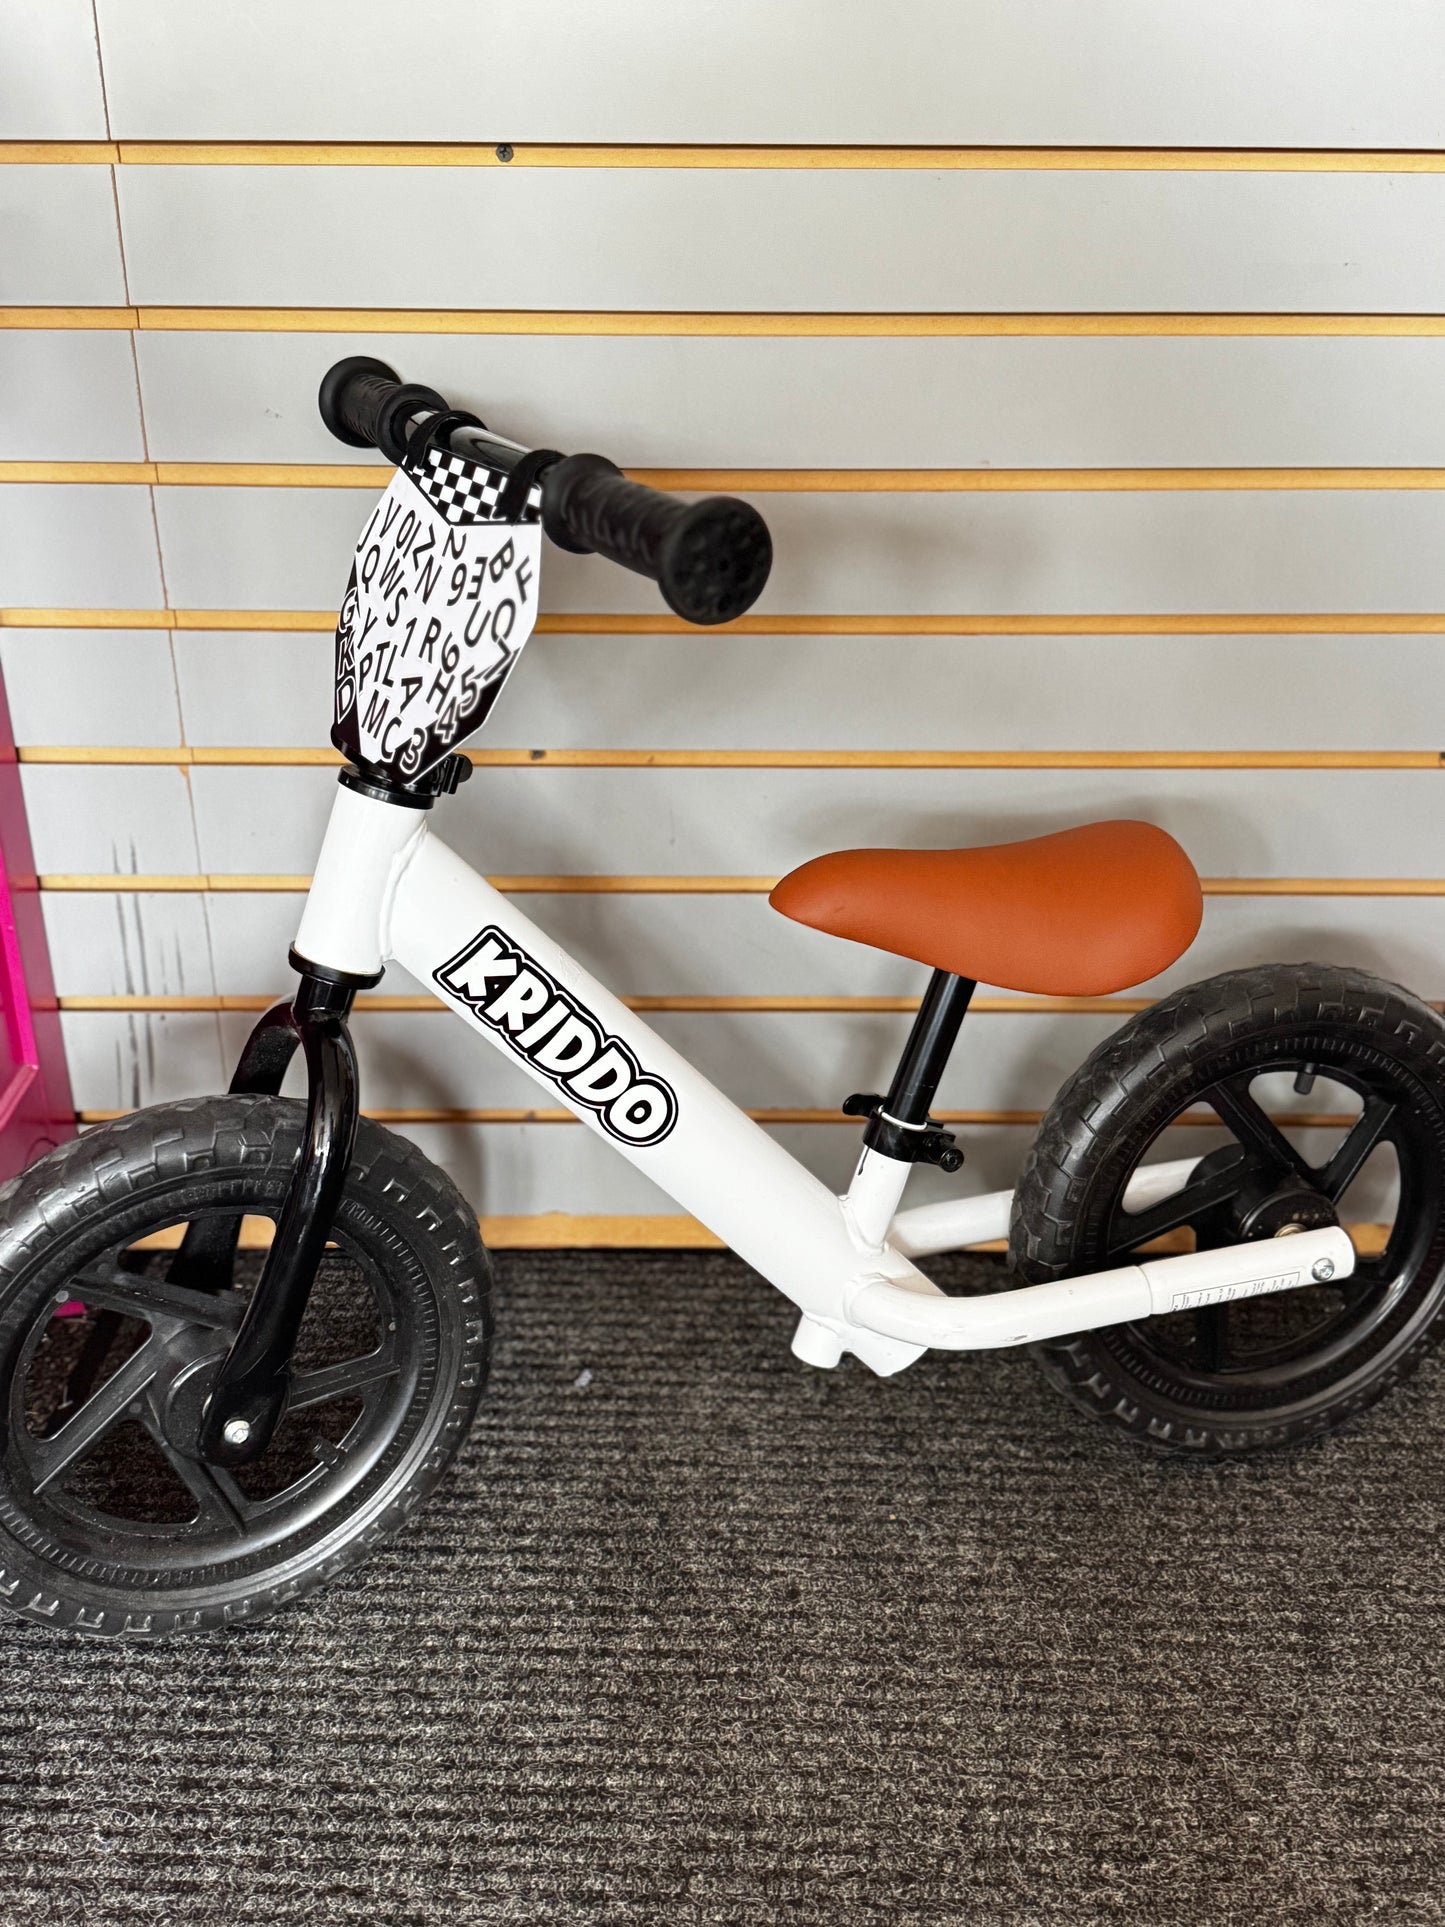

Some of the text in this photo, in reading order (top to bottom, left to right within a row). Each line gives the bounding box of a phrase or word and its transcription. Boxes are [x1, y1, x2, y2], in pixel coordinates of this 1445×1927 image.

[356, 508, 380, 553] J
[379, 496, 402, 538] V
[442, 527, 467, 560] 2
[488, 536, 515, 583] B
[361, 544, 380, 594] Q
[379, 546, 405, 601] W
[414, 554, 443, 605] N
[466, 556, 488, 599] E
[515, 555, 533, 605] F
[339, 588, 357, 631] G
[357, 607, 378, 650] Y
[386, 586, 409, 628] S
[463, 600, 492, 648] U
[337, 629, 356, 680] K
[373, 640, 391, 683] T
[418, 616, 442, 665] R
[441, 631, 460, 675] 6
[359, 651, 373, 693] P
[381, 644, 398, 688] L
[336, 675, 357, 724] D
[399, 676, 423, 715] A
[425, 667, 456, 716] H
[460, 664, 480, 716] 5
[361, 689, 390, 740] M
[380, 716, 403, 760] C
[434, 695, 457, 743] 4
[400, 727, 427, 774] 3
[436, 928, 675, 1144] KRIDDO
